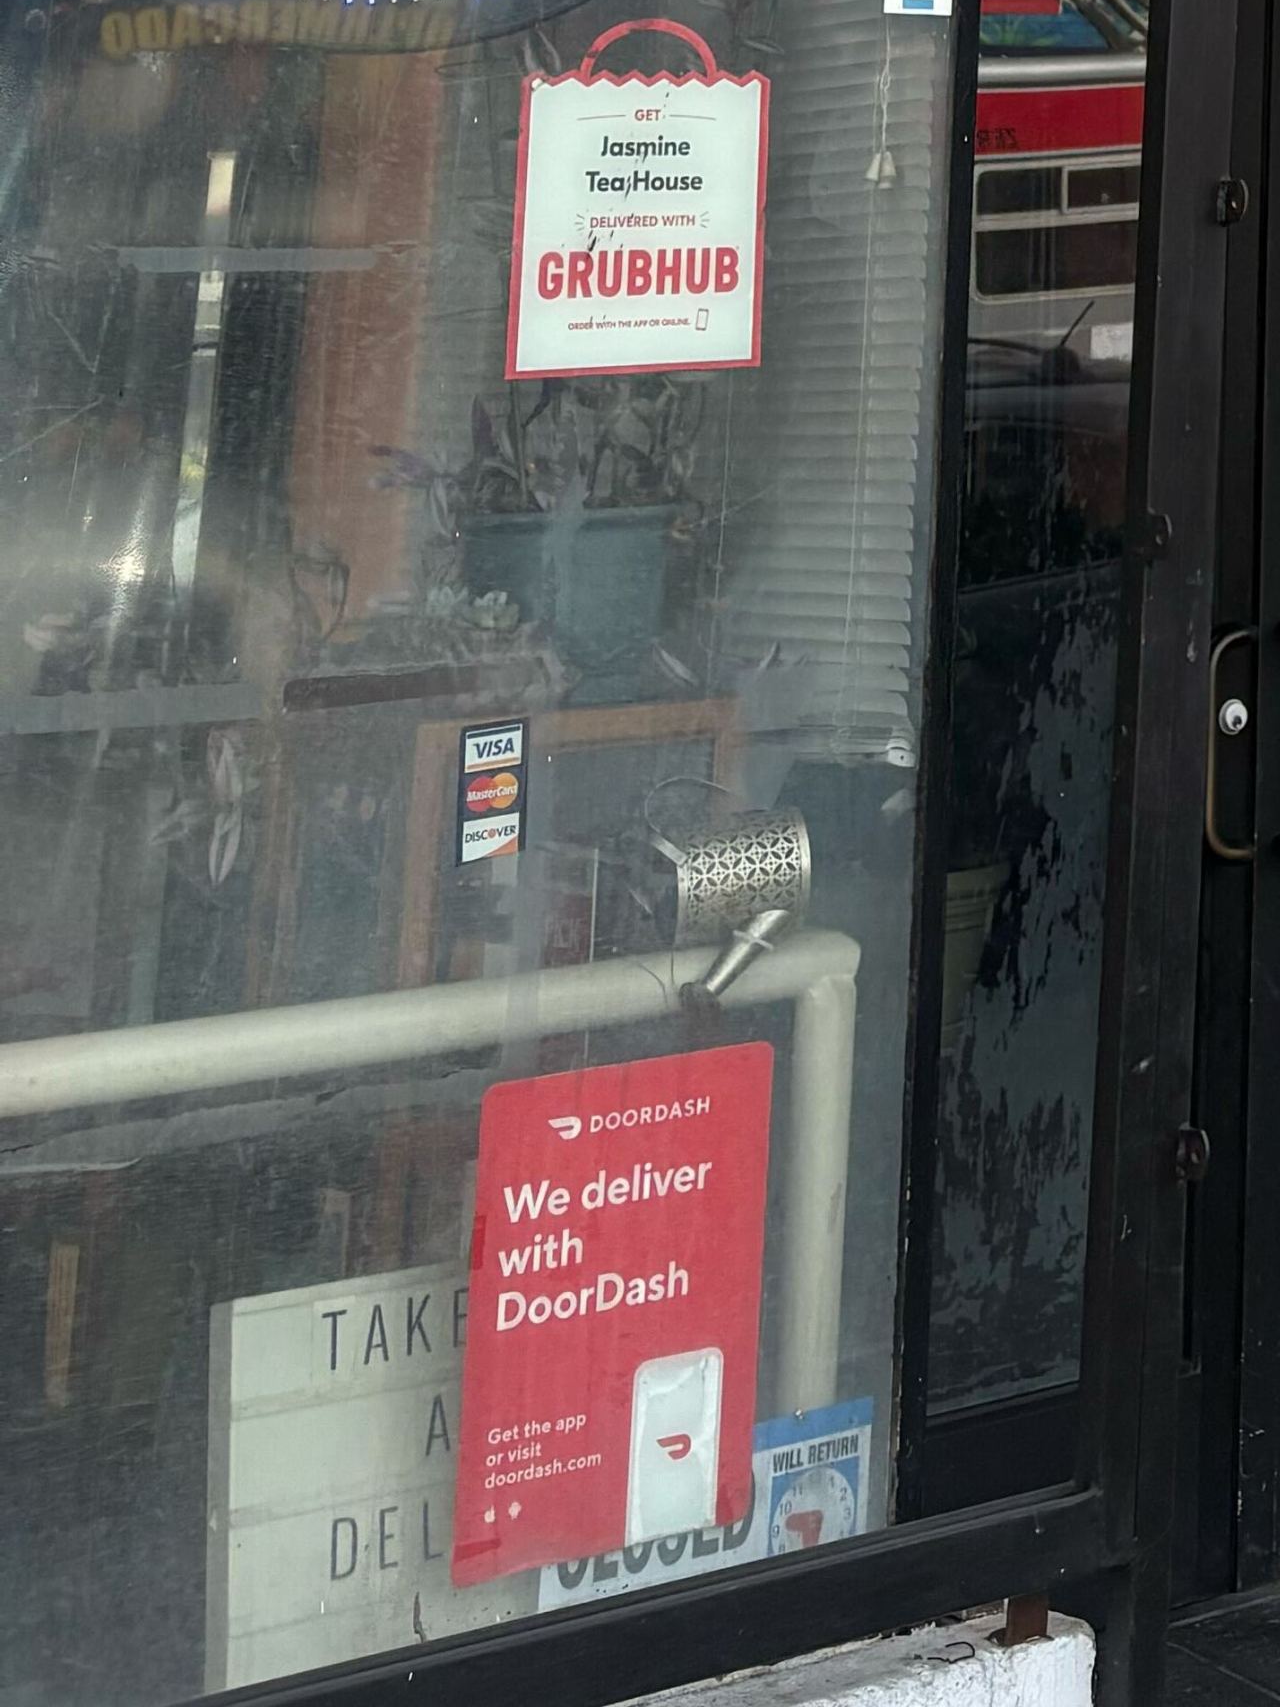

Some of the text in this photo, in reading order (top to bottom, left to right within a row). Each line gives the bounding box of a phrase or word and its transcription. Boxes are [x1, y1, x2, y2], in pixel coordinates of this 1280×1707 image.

[634, 109, 661, 122] GET
[600, 135, 691, 158] Jasmine
[585, 171, 703, 193] Tea House
[590, 215, 695, 229] DELIVERED WITH
[537, 247, 740, 300] GRUBHUB
[473, 738, 514, 760] VISA
[466, 782, 518, 803] MasterCard
[465, 823, 516, 844] DISCOVER
[589, 1096, 711, 1134] DOORDASH
[503, 1159, 712, 1224] We deliver
[497, 1229, 583, 1277] with
[496, 1262, 690, 1332] DoorDash
[321, 1287, 470, 1371] TAKE
[487, 1412, 587, 1446] Get the app
[484, 1449, 602, 1490] doordash.com
[486, 1441, 542, 1467] or visit
[772, 1434, 860, 1474] WILL RETURN
